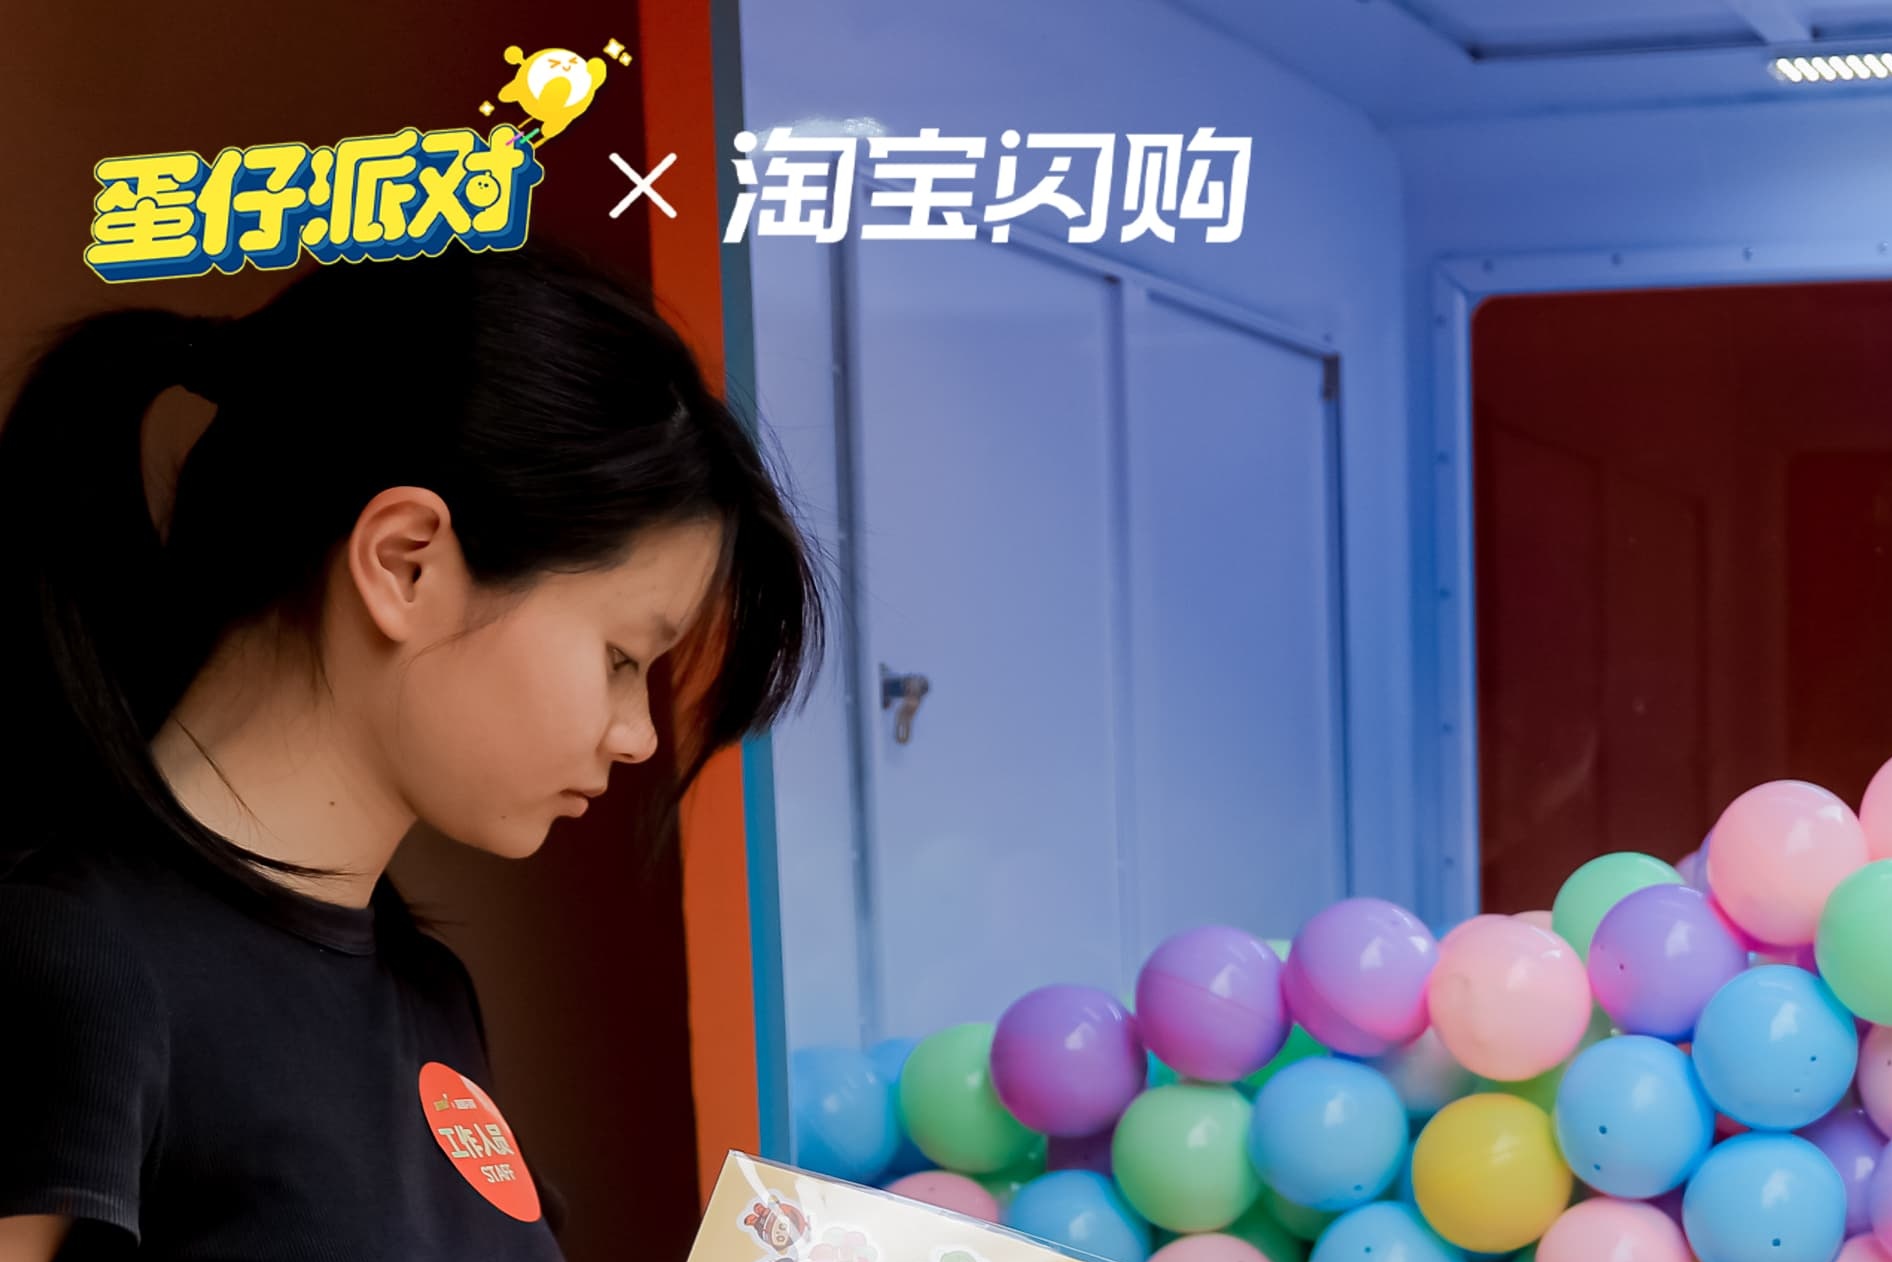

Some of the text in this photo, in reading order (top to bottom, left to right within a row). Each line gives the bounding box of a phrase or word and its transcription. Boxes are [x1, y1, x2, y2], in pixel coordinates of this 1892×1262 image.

[438, 1123, 515, 1159] 工作人员
[480, 1163, 516, 1183] STAFF
